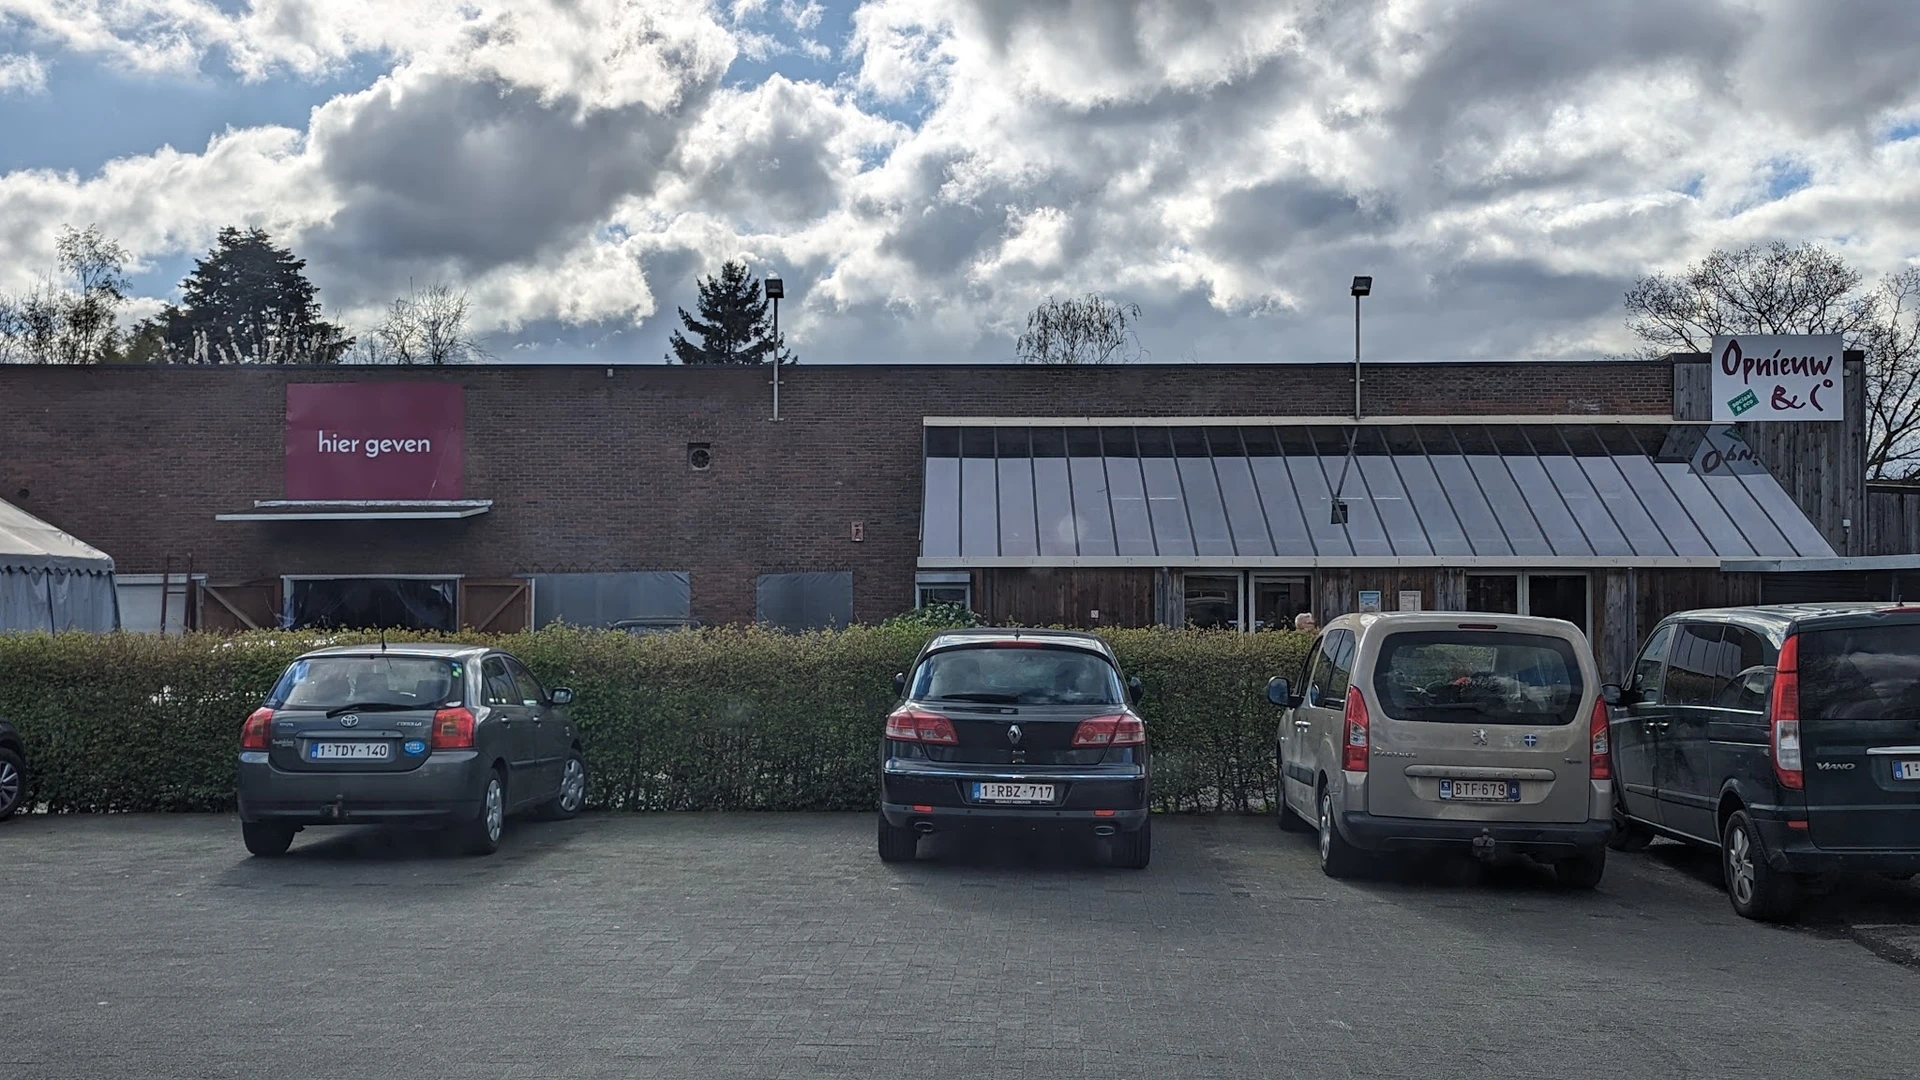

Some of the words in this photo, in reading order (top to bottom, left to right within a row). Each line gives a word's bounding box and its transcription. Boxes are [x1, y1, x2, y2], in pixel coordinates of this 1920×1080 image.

[1721, 338, 1833, 385] Opnieuw
[1771, 385, 1806, 411] &
[318, 429, 360, 453] hier
[365, 439, 431, 458] geven
[1816, 762, 1856, 770] VIANO
